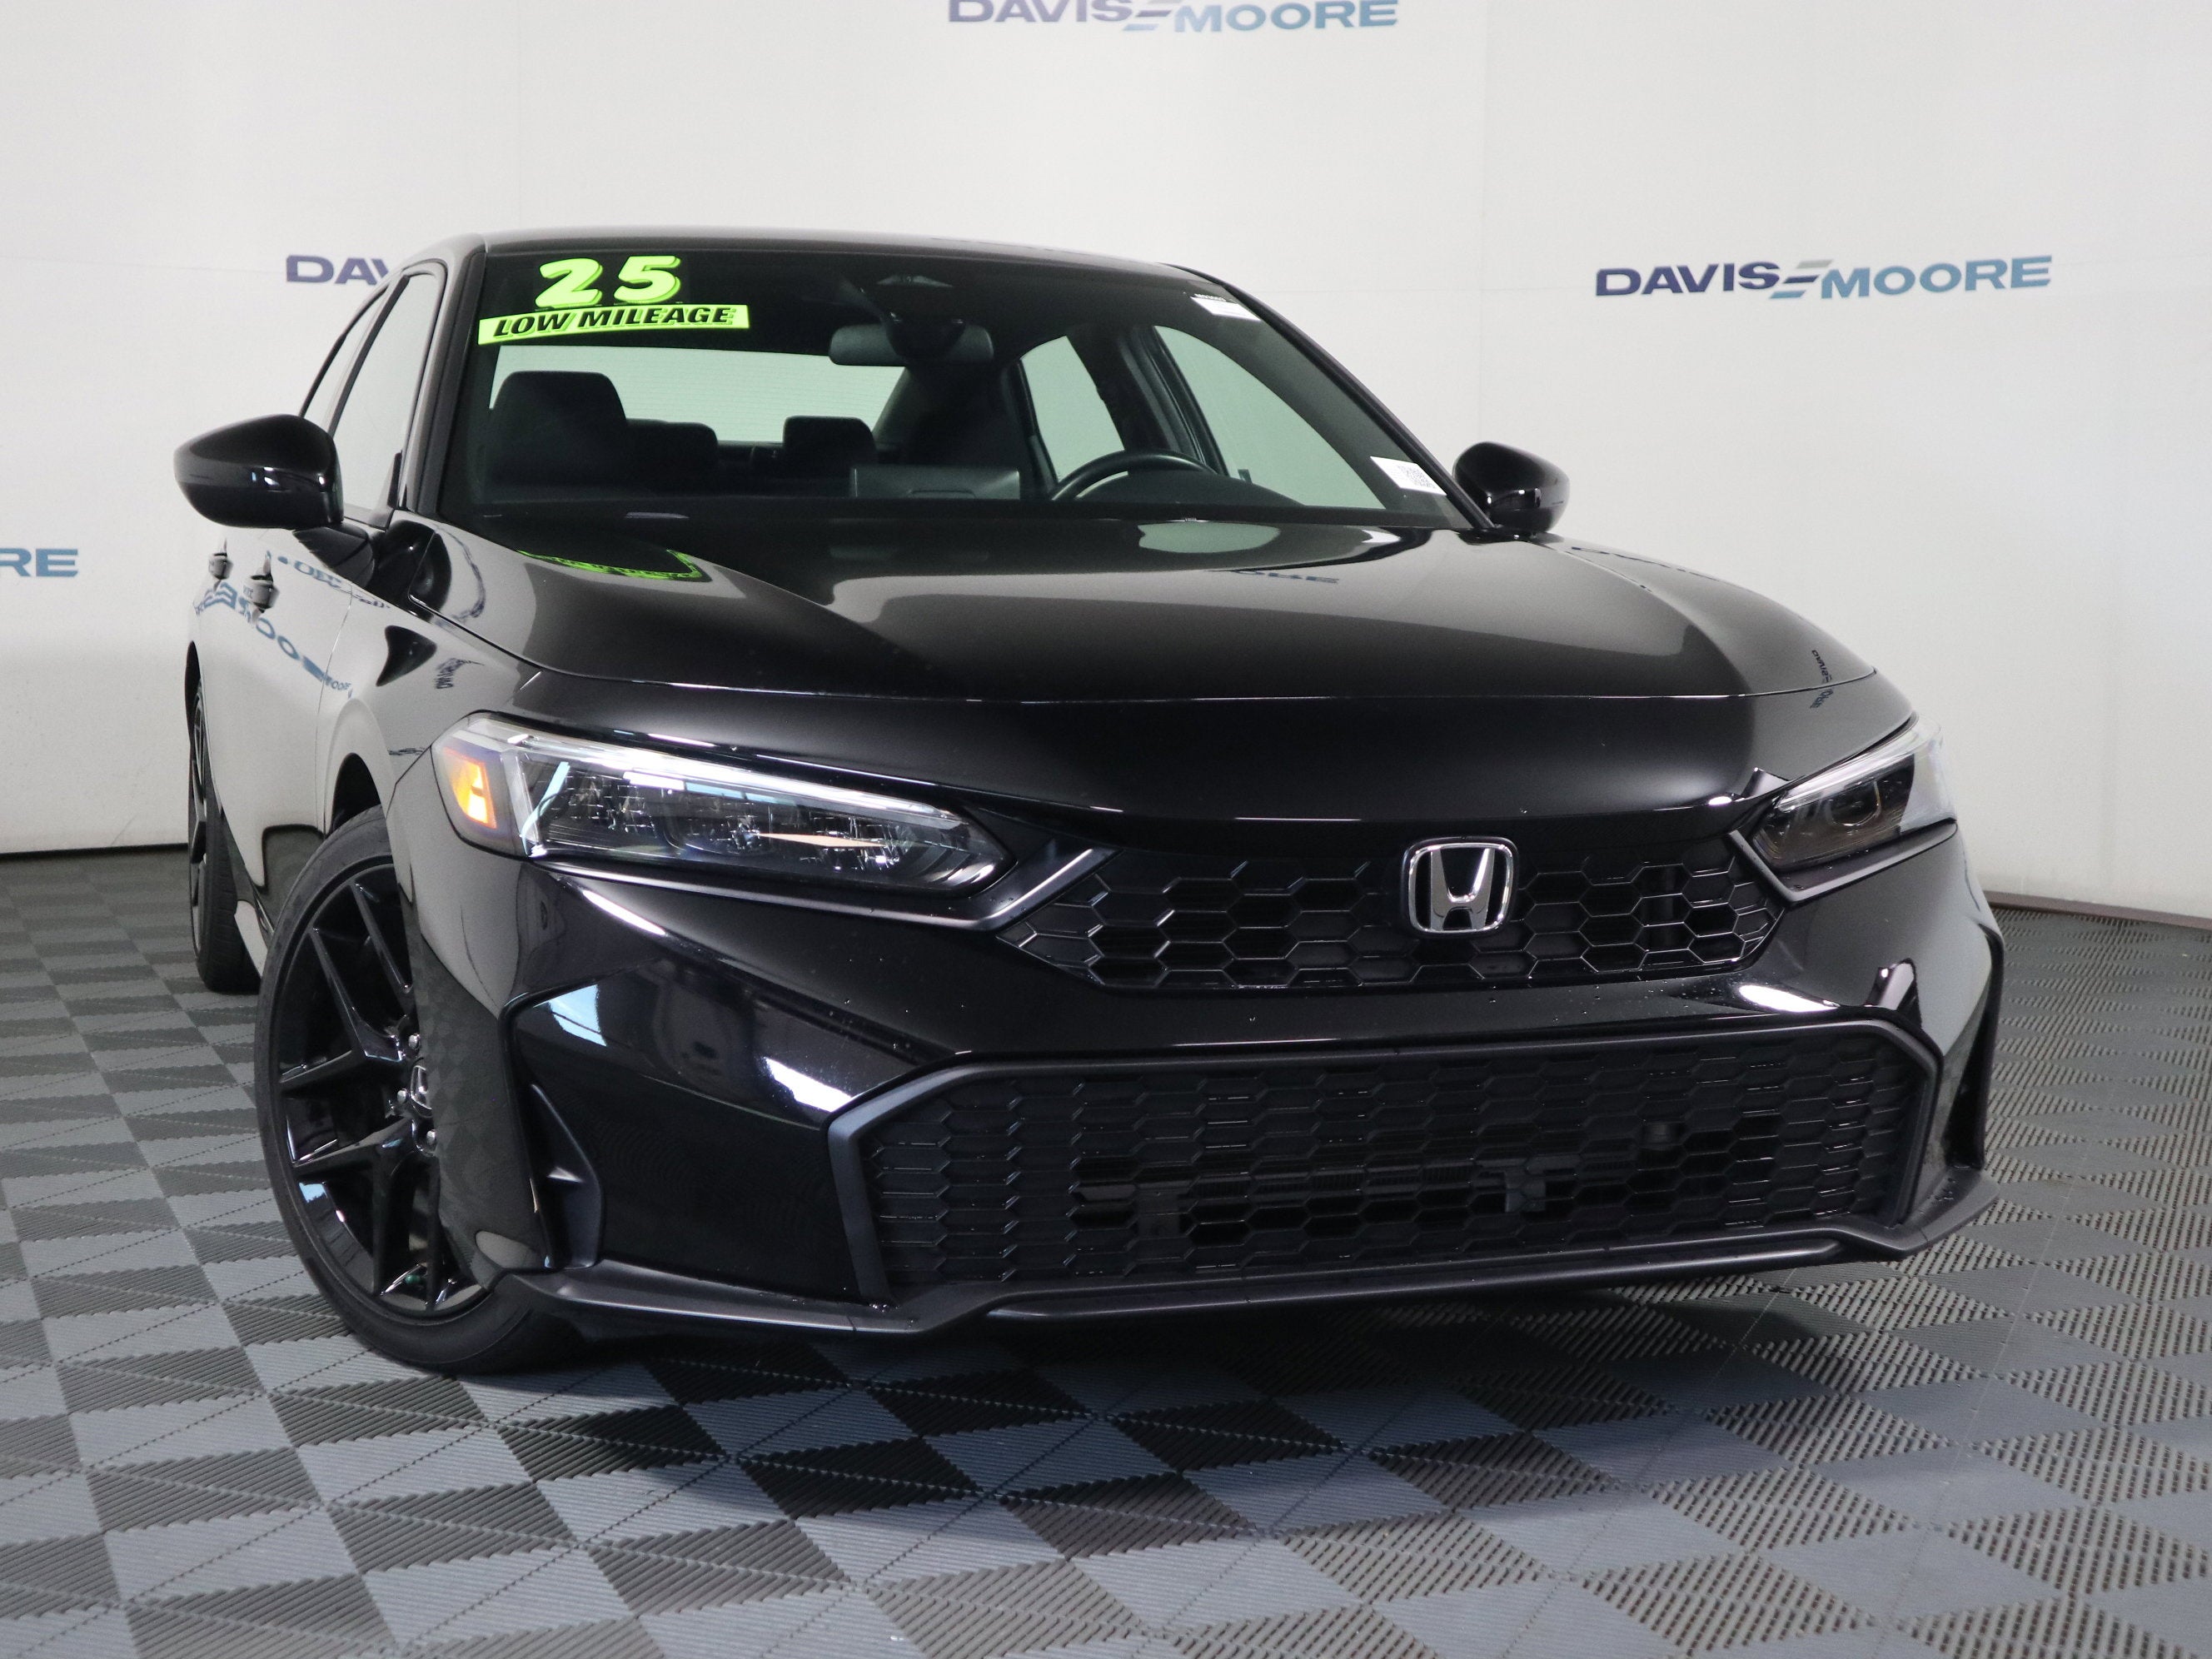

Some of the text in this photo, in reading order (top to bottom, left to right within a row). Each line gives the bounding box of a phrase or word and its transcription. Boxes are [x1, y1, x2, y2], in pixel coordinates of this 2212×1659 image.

[948, 0, 1399, 32] DAVIS MOORE
[535, 255, 681, 309] 25
[1596, 255, 2053, 299] DAVIS MOORE
[493, 306, 736, 339] LOW MILEAGE
